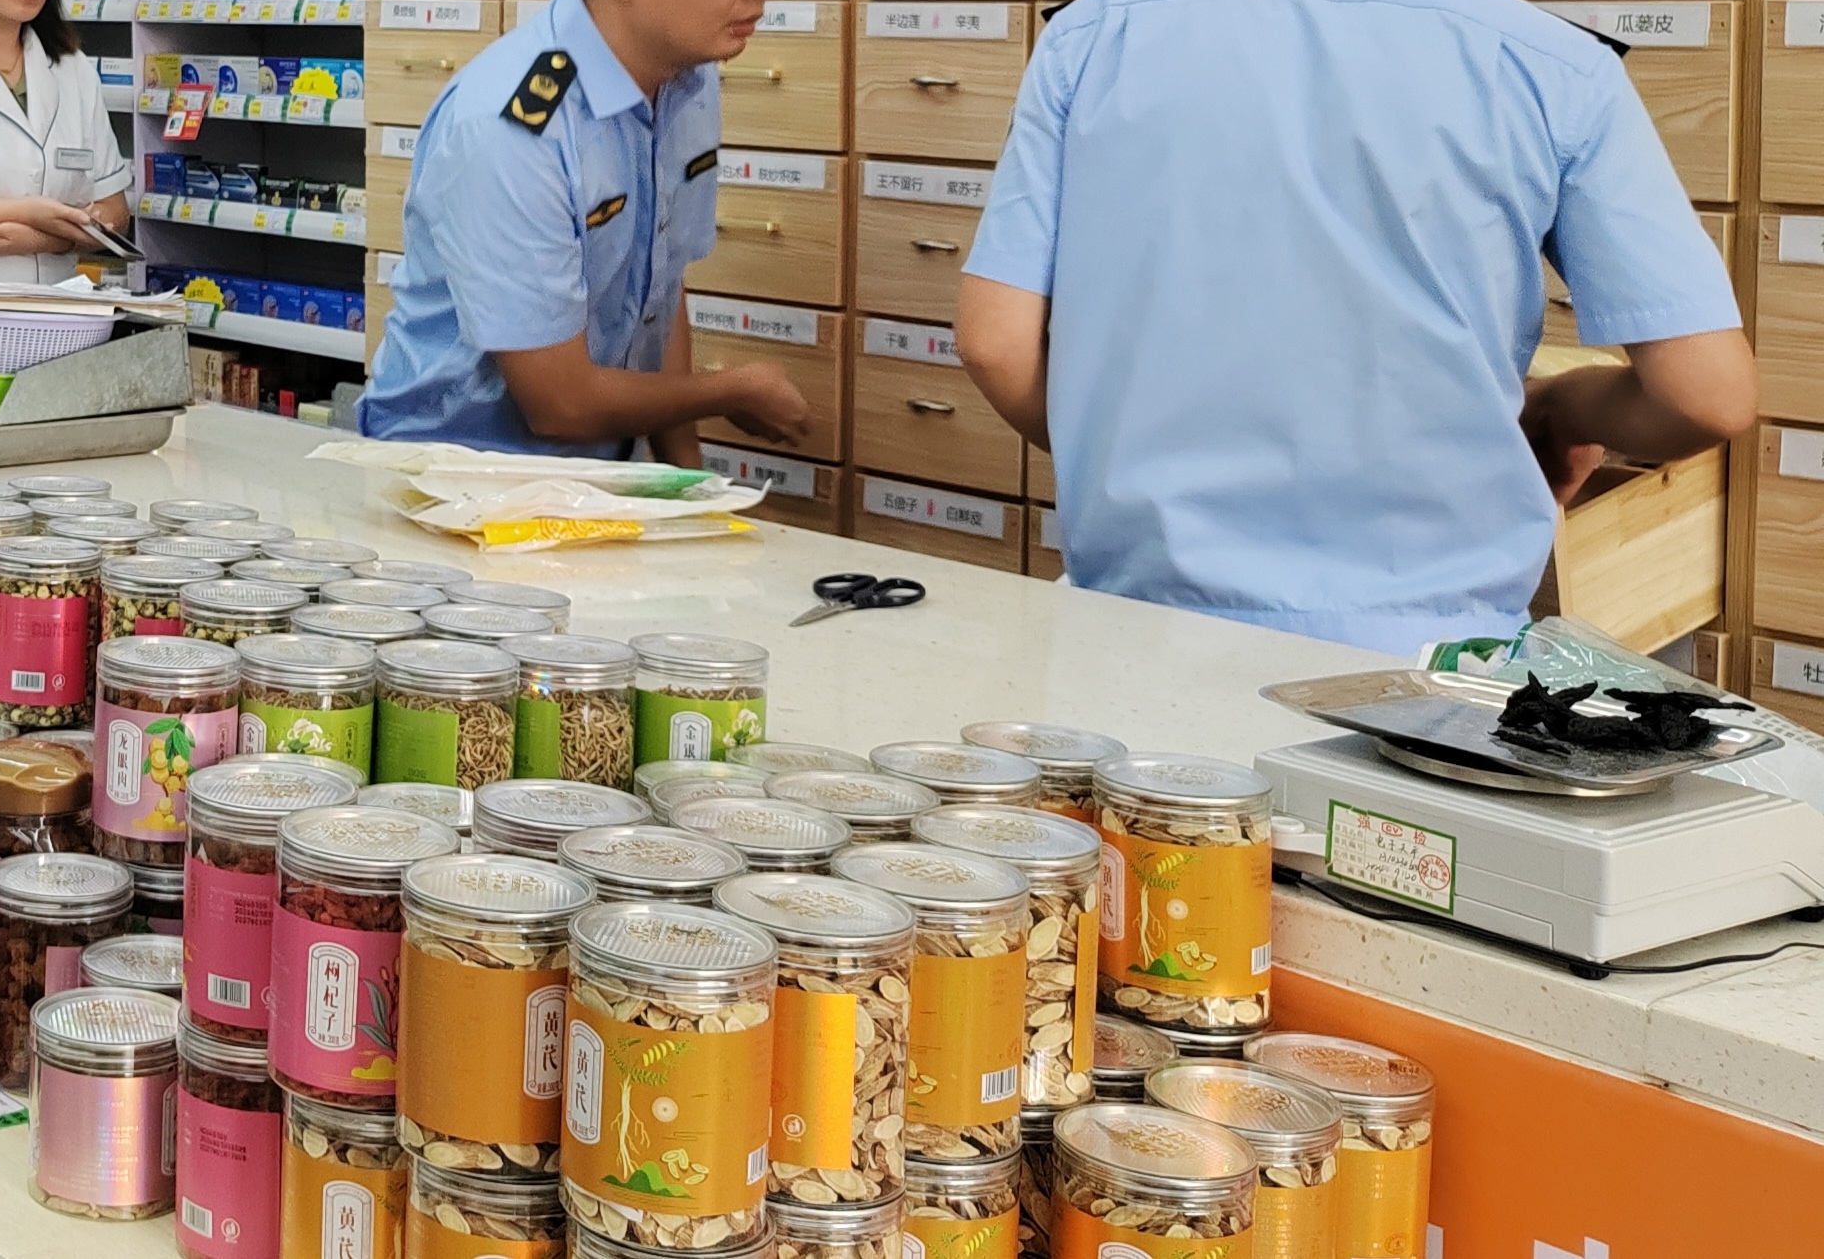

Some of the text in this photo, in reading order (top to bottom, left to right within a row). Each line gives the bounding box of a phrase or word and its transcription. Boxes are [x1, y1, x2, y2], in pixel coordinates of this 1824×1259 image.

[1614, 12, 1674, 35] 瓜蒌皮
[116, 732, 129, 789] 龙眼肉
[323, 958, 341, 1034] 枸杞子
[542, 1010, 560, 1073] 黄芪
[574, 1048, 588, 1116] 黄芪
